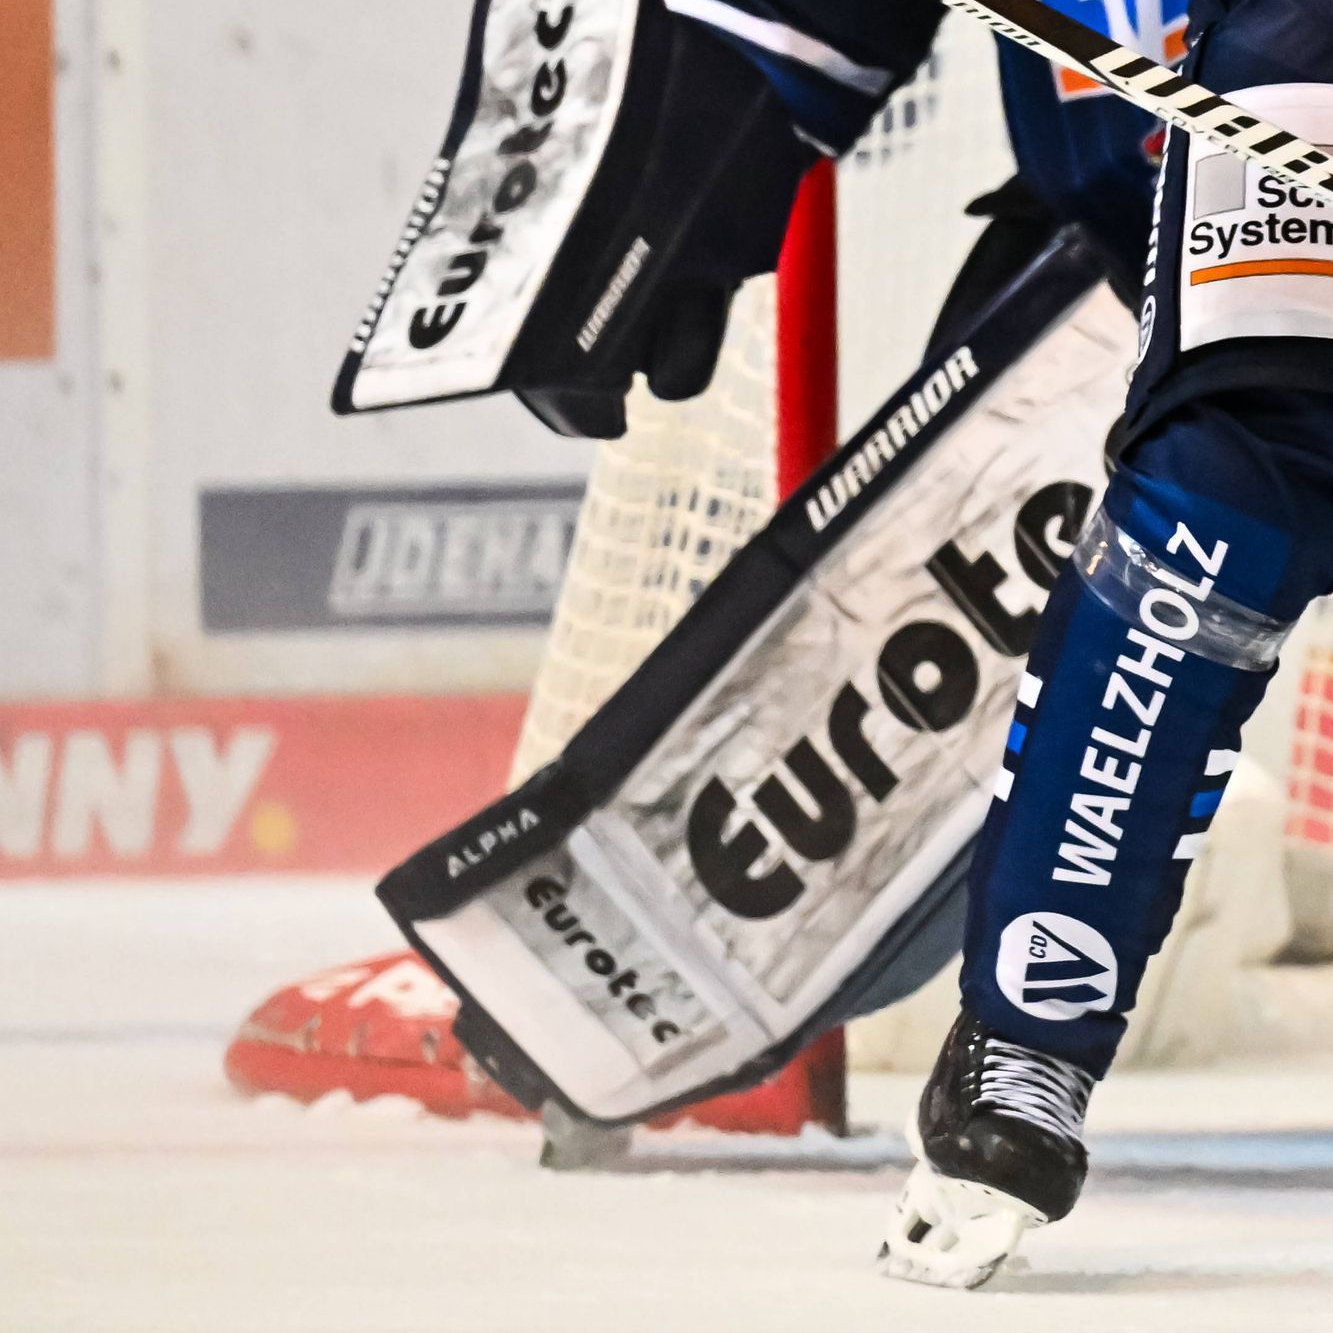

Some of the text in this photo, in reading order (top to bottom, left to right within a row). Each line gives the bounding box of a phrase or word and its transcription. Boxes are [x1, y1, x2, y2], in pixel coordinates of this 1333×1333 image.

[408, 4, 573, 350] Eurotec
[804, 345, 981, 533] WARRIOR
[686, 480, 1095, 922] Eurote
[1052, 520, 1230, 888] WAELZHOLZ
[446, 807, 541, 877] ALPHA
[522, 874, 692, 1046] Eurotec
